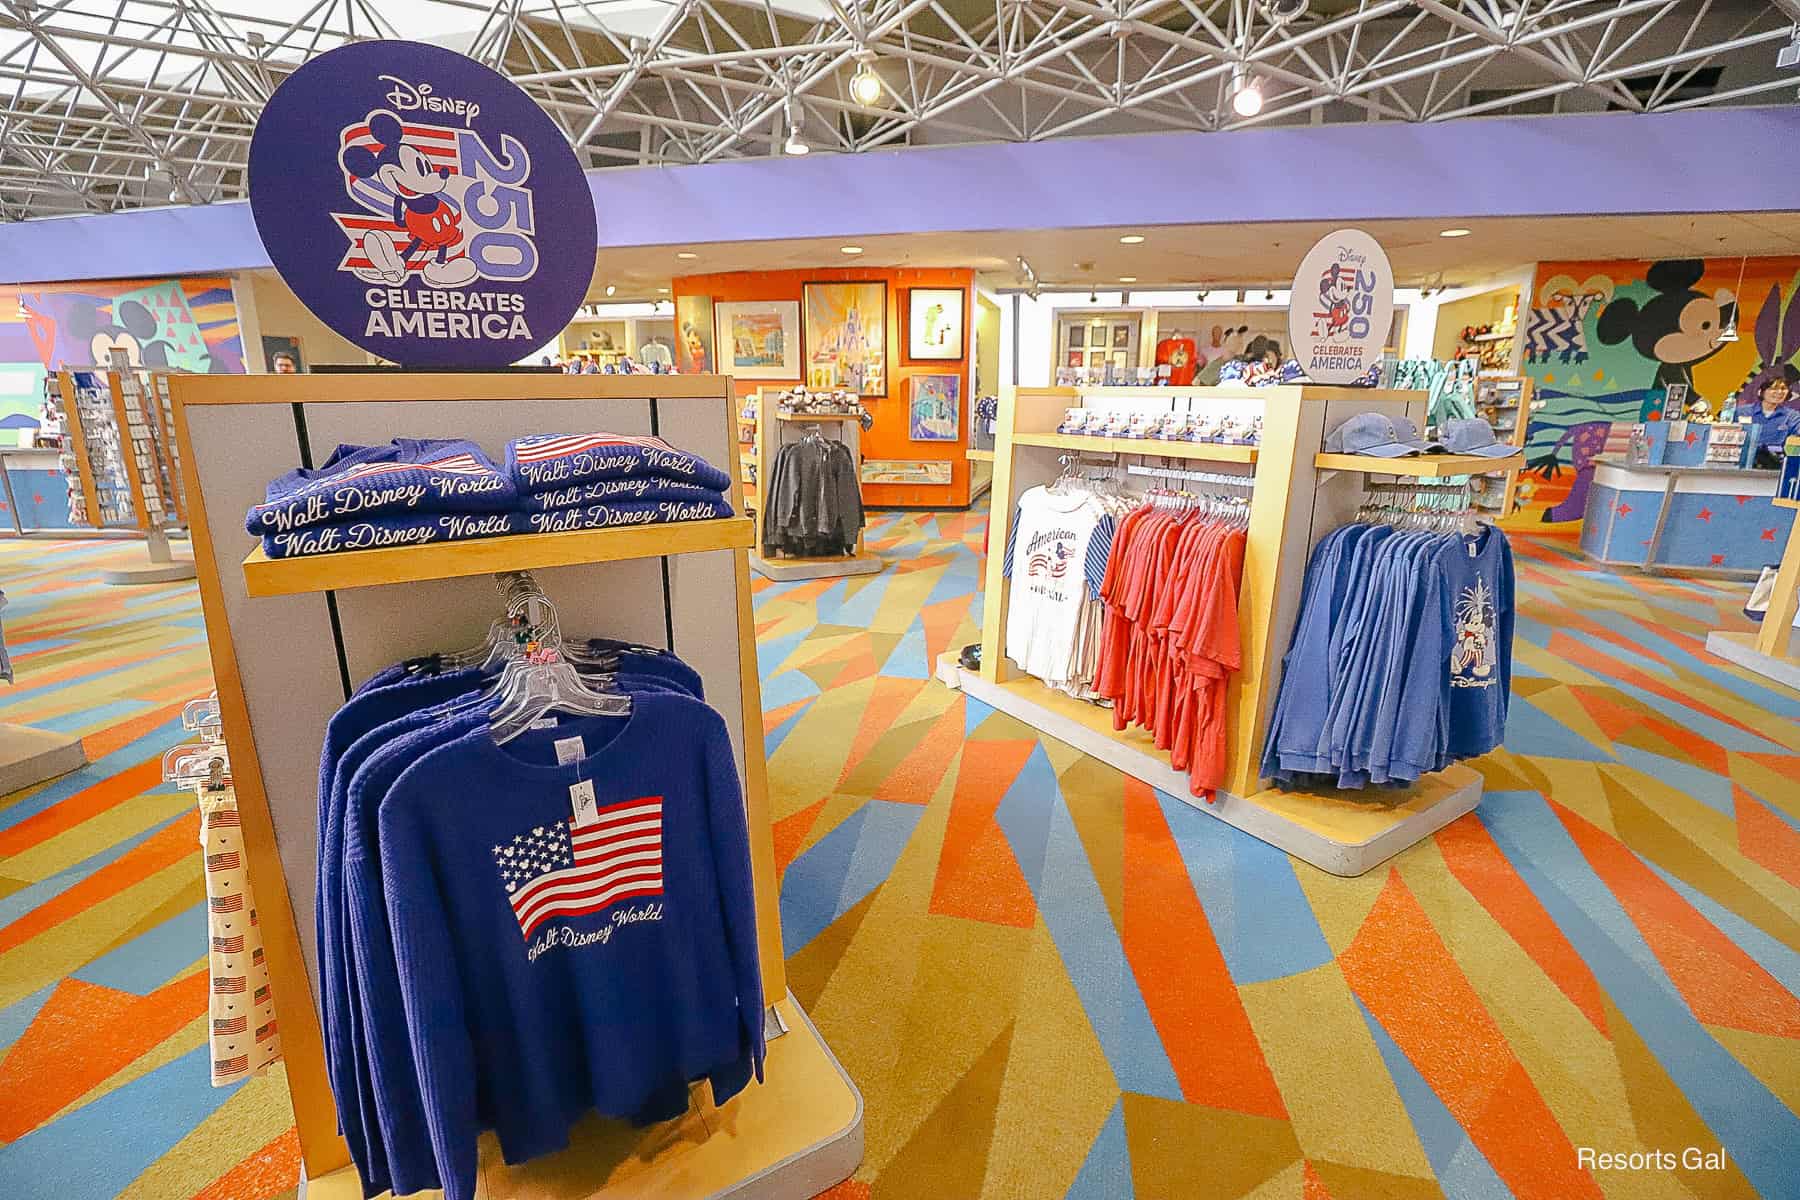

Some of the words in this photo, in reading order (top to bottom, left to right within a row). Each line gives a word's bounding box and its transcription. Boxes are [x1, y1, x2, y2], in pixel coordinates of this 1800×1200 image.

[378, 75, 480, 127] Disney
[457, 131, 539, 282] 250
[1337, 246, 1367, 267] Disney
[365, 288, 525, 313] CELEBRATES
[1349, 269, 1376, 339] 250
[364, 311, 533, 341] AMERICA
[1310, 357, 1362, 370] AMERICA
[1312, 345, 1363, 356] CELEBRATES
[520, 460, 570, 487] Walt
[572, 453, 640, 476] Disney
[640, 447, 697, 475] World
[262, 495, 329, 532] Walt
[334, 485, 427, 514] Disney
[430, 475, 505, 497] World
[534, 490, 583, 509] Walt
[585, 479, 650, 499] Disney
[530, 508, 582, 534] Walt
[585, 505, 658, 529] Disney
[659, 500, 717, 523] World
[275, 527, 342, 557] Walt
[345, 522, 438, 548] Disney
[439, 514, 511, 539] World
[1026, 528, 1077, 556] American
[528, 928, 559, 963] Walt
[560, 925, 613, 947] Disney
[612, 903, 663, 927] World
